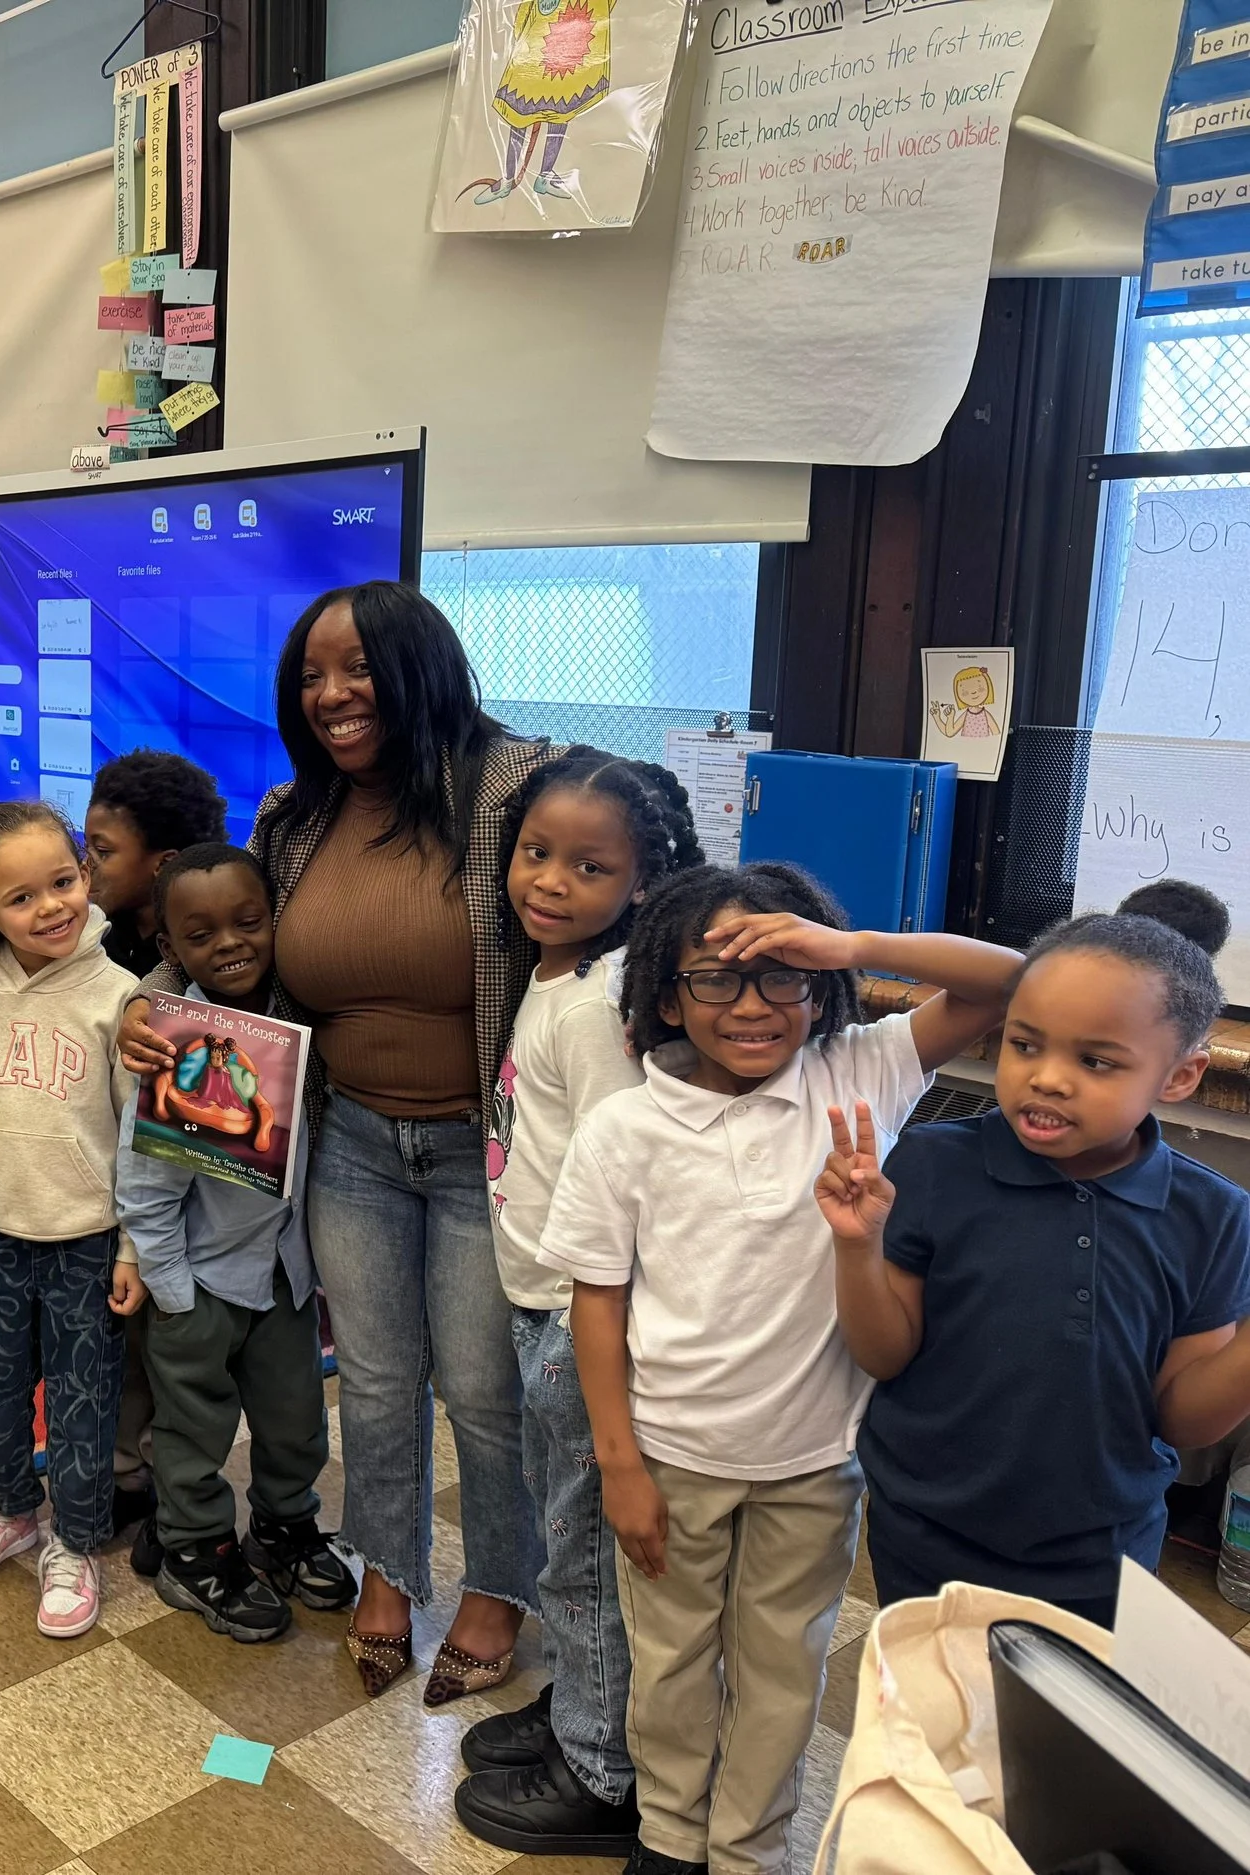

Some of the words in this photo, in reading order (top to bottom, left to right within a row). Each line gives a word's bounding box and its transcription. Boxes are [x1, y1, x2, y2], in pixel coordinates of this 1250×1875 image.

[711, 2, 844, 50] Classroom
[1200, 36, 1225, 56] be
[1231, 30, 1249, 48] in
[121, 58, 160, 91] POWER
[167, 51, 181, 73] of
[188, 43, 199, 66] 3
[719, 67, 785, 105] Follow
[789, 54, 876, 93] directions
[888, 34, 918, 71] the
[926, 26, 969, 58] first
[979, 23, 1026, 51] time.
[183, 66, 198, 89] We
[119, 91, 132, 109] We
[151, 82, 165, 104] We
[186, 91, 198, 122] take
[695, 126, 710, 152] 2.
[716, 119, 752, 150] Feet,
[808, 96, 841, 133] and
[848, 86, 912, 132] objects
[921, 80, 936, 109] to
[943, 71, 1015, 115] yourself.
[118, 109, 130, 141] take
[152, 106, 164, 135] take
[151, 138, 160, 163] care
[186, 125, 194, 151] care
[117, 143, 126, 171] care
[186, 153, 196, 166] of
[707, 157, 749, 189] Small
[759, 155, 806, 180] voices
[865, 128, 892, 165] tall
[898, 134, 941, 158] voices
[947, 115, 1001, 150] outside.
[118, 175, 128, 188] of
[151, 165, 162, 177] of
[186, 169, 194, 189] our
[150, 183, 163, 212] each
[702, 197, 747, 233] Work
[845, 183, 868, 215] be
[1187, 188, 1227, 211] pay
[797, 236, 847, 262] ROAR
[132, 259, 151, 275] Stay
[156, 261, 165, 271] in
[1182, 259, 1225, 281] take
[131, 275, 148, 287] your
[101, 306, 143, 319] exercise
[167, 313, 185, 325] take
[189, 311, 206, 321] care
[167, 325, 178, 338] of
[181, 321, 214, 335] materials
[132, 343, 146, 356] be
[150, 342, 167, 356] nice
[163, 398, 179, 415] put
[180, 385, 204, 404] things
[168, 404, 192, 423] where
[192, 393, 208, 410] they
[205, 390, 216, 402] go
[72, 450, 104, 468] above
[333, 507, 376, 526] SMART
[37, 569, 58, 580] Recent
[59, 569, 73, 579] files
[118, 566, 145, 577] Favorite
[146, 565, 161, 575] files
[1199, 818, 1232, 853] is
[155, 998, 183, 1018] Zuri
[187, 1009, 210, 1023] and
[213, 1012, 236, 1030] the
[238, 1020, 292, 1048] Monster
[184, 1147, 212, 1163] Written
[213, 1156, 222, 1165] by
[223, 1159, 247, 1173] Tanisha
[247, 1167, 279, 1185] Chambers
